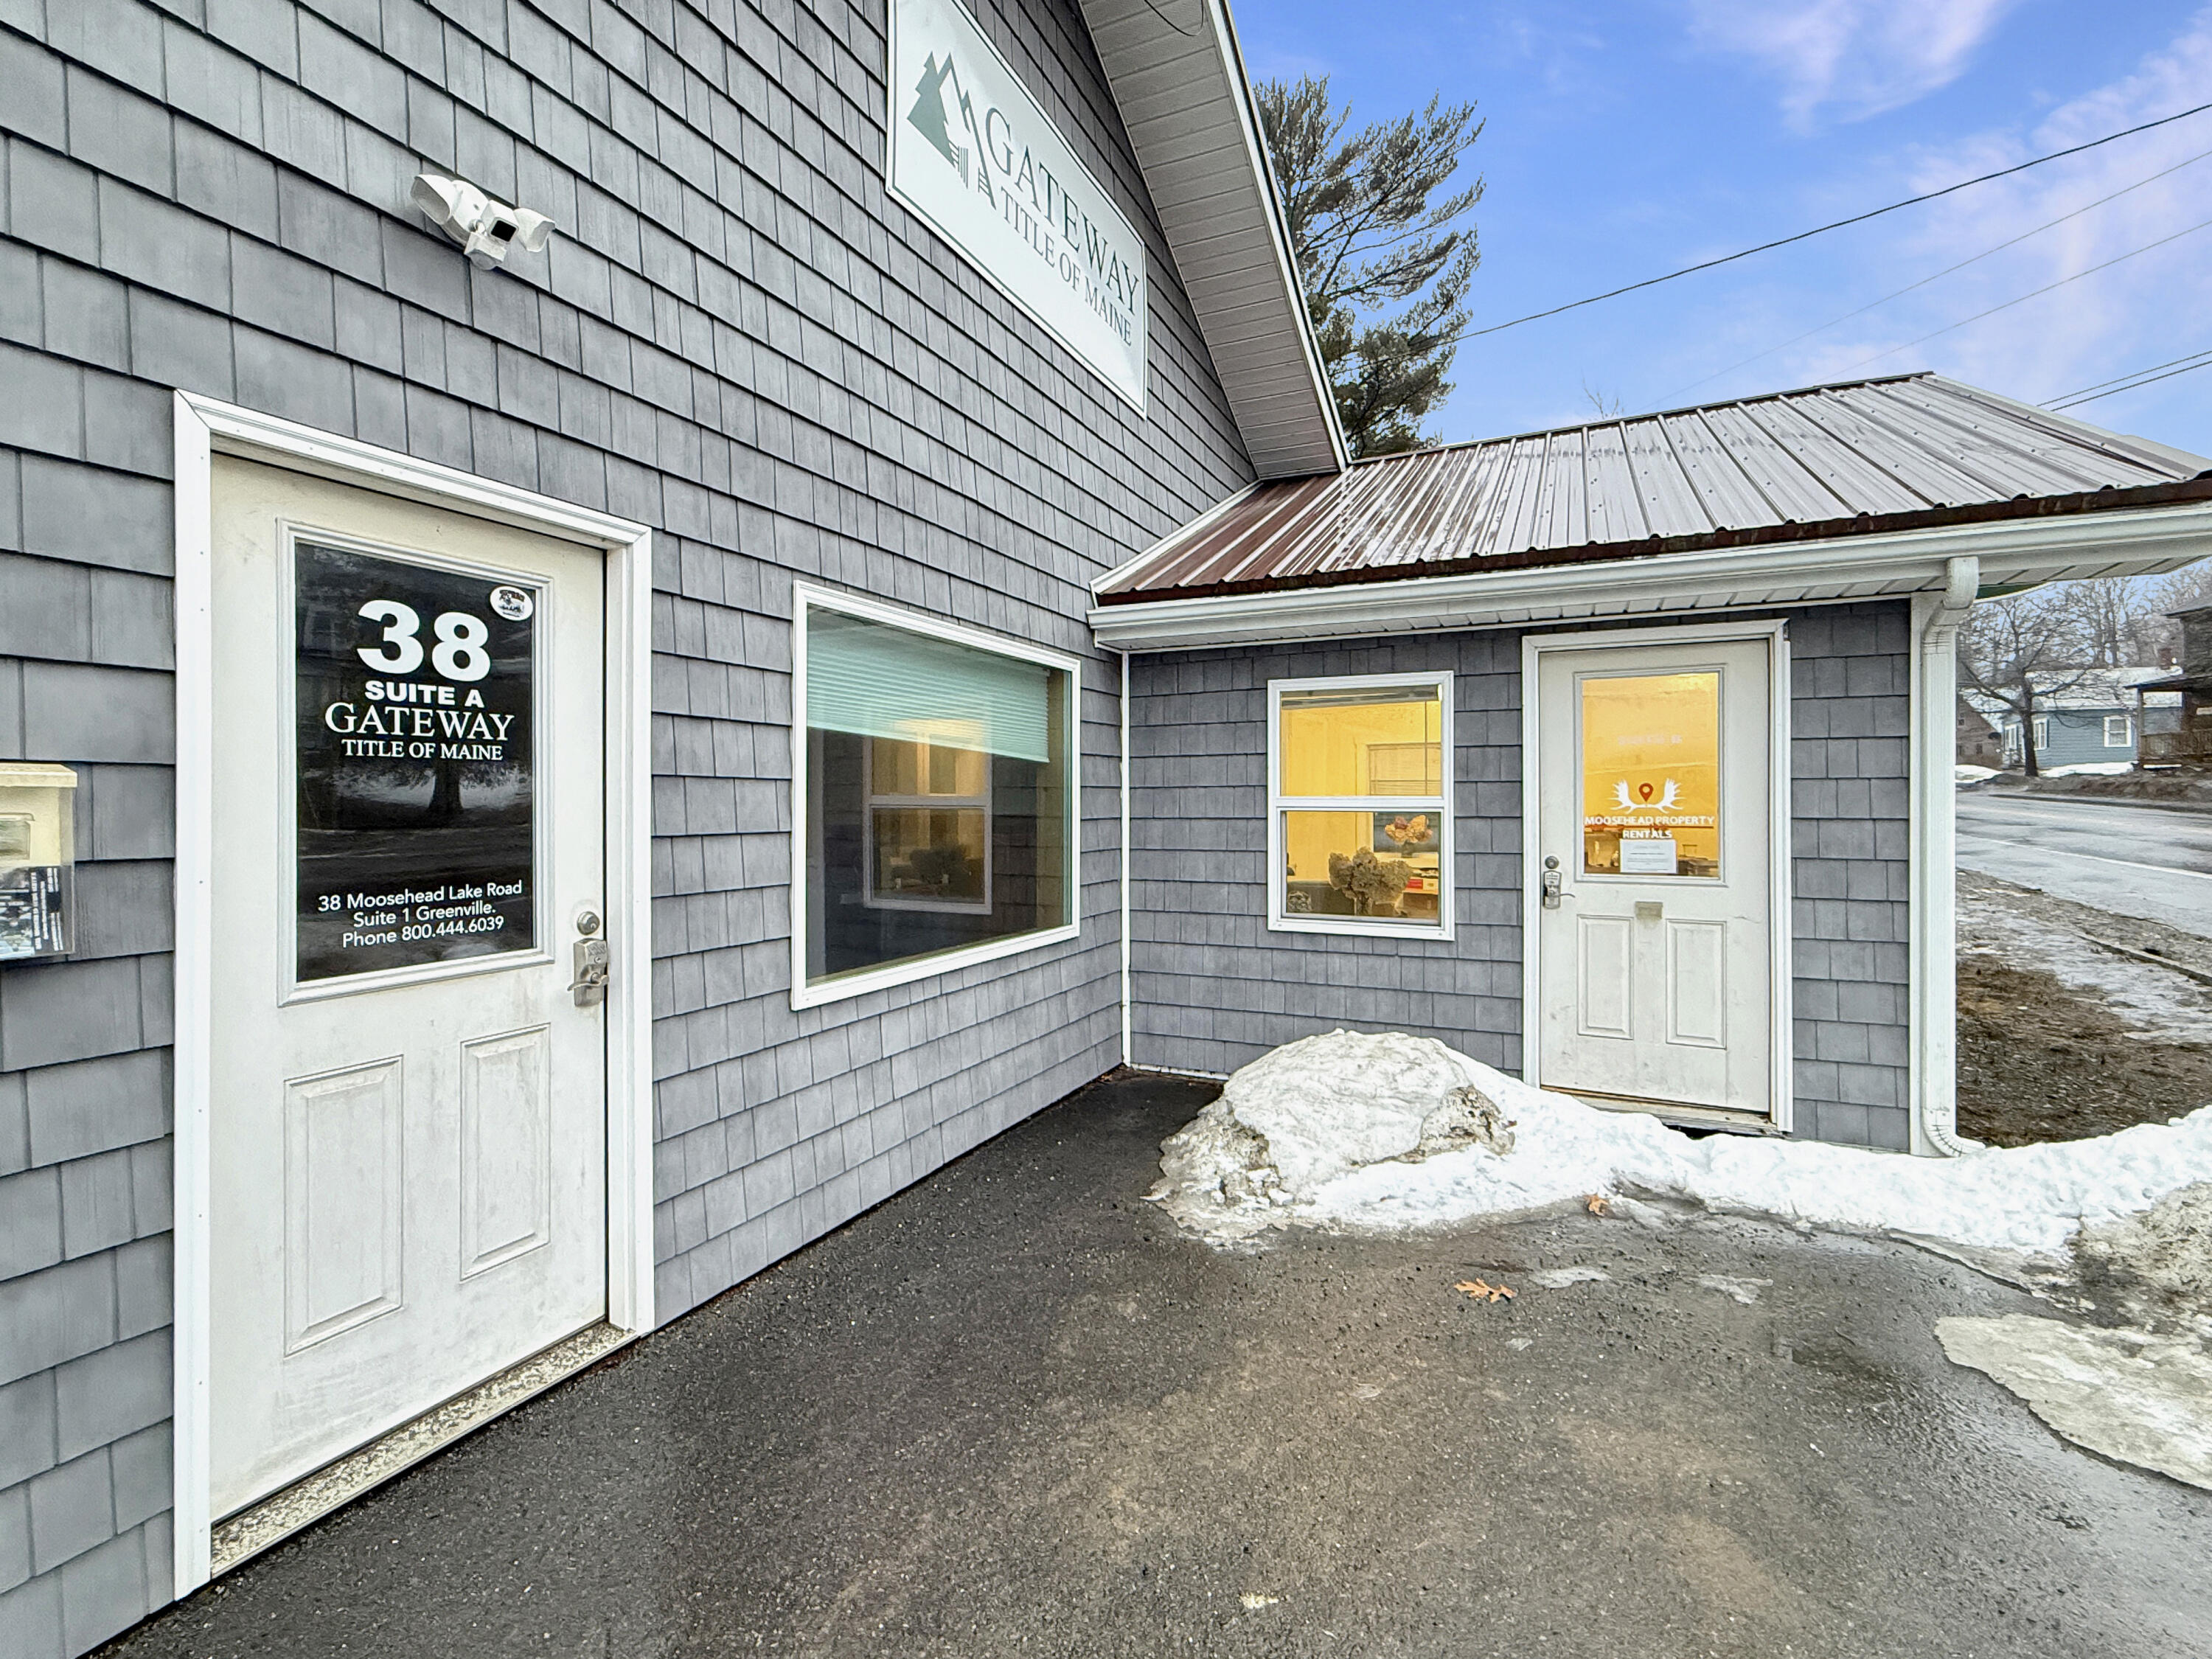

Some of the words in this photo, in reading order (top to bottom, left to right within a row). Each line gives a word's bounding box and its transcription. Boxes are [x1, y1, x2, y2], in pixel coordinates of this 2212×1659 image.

[986, 108, 1139, 316] GATEWAY
[1001, 186, 1055, 268] TITLE
[1060, 252, 1082, 292] OF
[1085, 276, 1132, 347] MAINE
[357, 599, 490, 681] 38
[365, 680, 455, 706] SUITE
[465, 689, 484, 708] A
[324, 702, 515, 741] GATEWAY
[341, 739, 404, 757] TITLE
[409, 742, 435, 759] OF
[440, 743, 503, 760] MAINE
[1585, 815, 1653, 825] MOOSEHEAD
[1655, 815, 1715, 825] PROPERTY
[1622, 830, 1672, 838] RENTALS
[318, 894, 341, 912] 38
[347, 886, 444, 909] Moosehead
[449, 884, 482, 901] Lake
[487, 880, 522, 897] Road
[353, 911, 396, 928] Suite
[402, 908, 410, 922] 1
[416, 900, 495, 921] Greenville.
[342, 928, 397, 948] Phone
[402, 916, 504, 942] 800.444.6039
